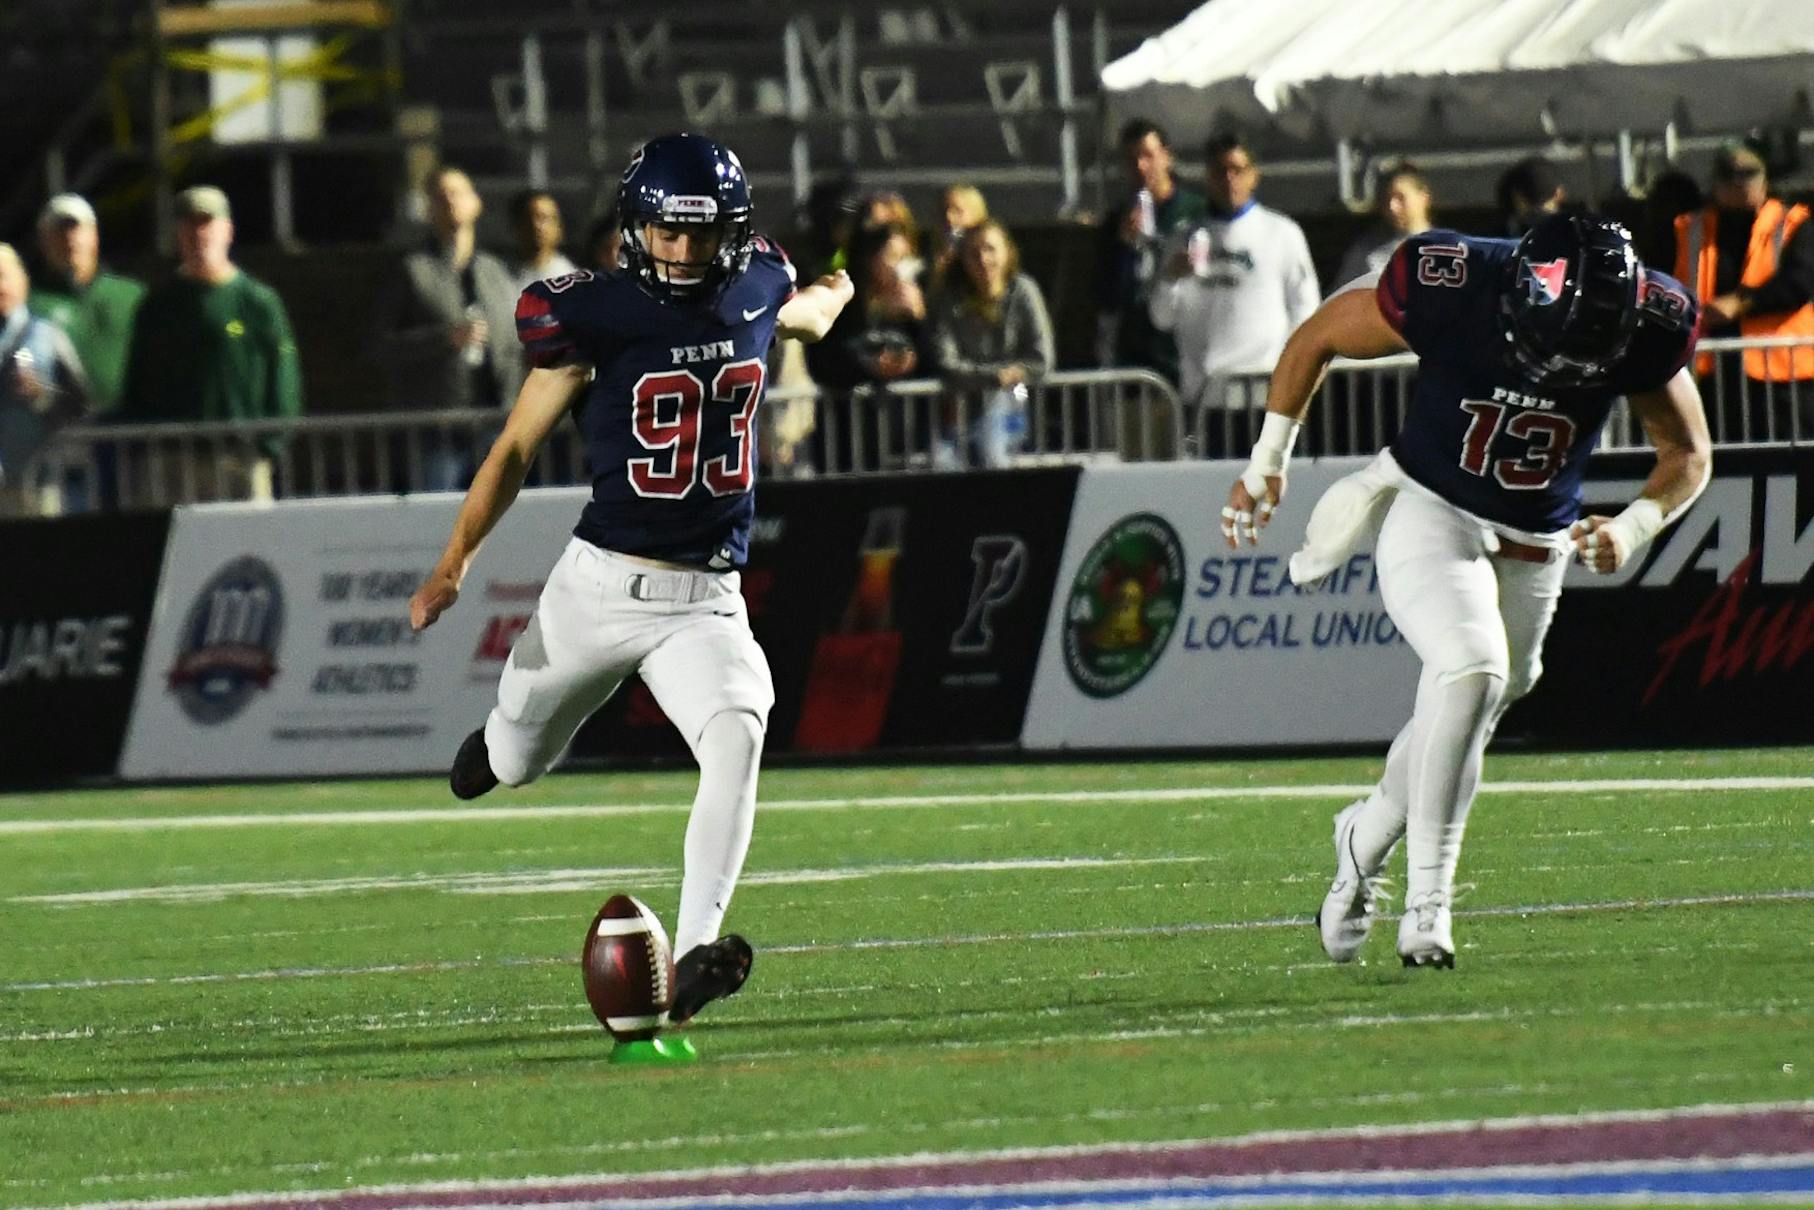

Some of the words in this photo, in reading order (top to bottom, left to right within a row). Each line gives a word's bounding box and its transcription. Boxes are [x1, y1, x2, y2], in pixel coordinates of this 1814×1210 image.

[1417, 241, 1469, 289] 13
[670, 339, 735, 365] PENN
[1491, 385, 1557, 411] PENN
[626, 357, 765, 501] 93
[1459, 397, 1577, 491] 13
[1184, 614, 1300, 650] LOCAL
[1312, 611, 1404, 646] UNIO
